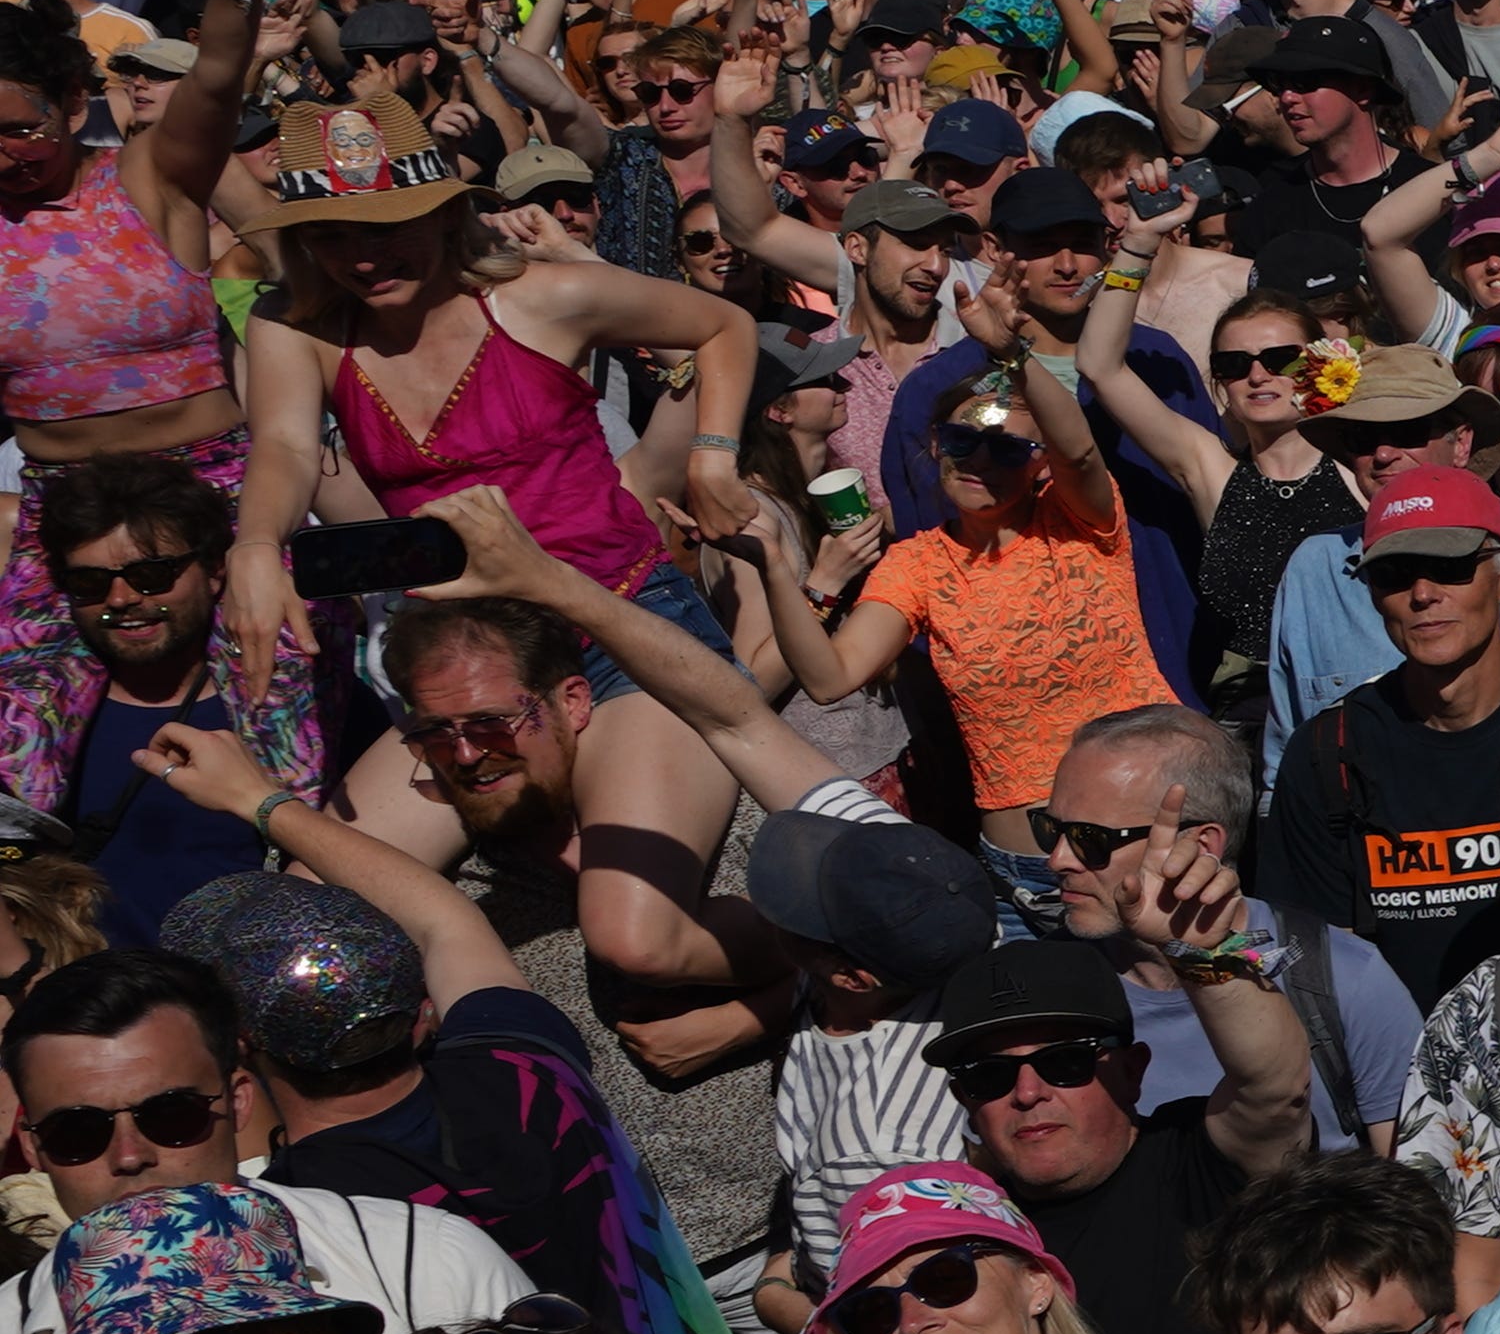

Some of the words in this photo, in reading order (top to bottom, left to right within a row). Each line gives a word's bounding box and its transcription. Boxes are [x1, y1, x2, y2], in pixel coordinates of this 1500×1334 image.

[1382, 496, 1434, 517] MUSTO
[1378, 838, 1445, 875] HAL
[1369, 891, 1421, 907] LOGIC
[1425, 880, 1500, 905] MEMORY
